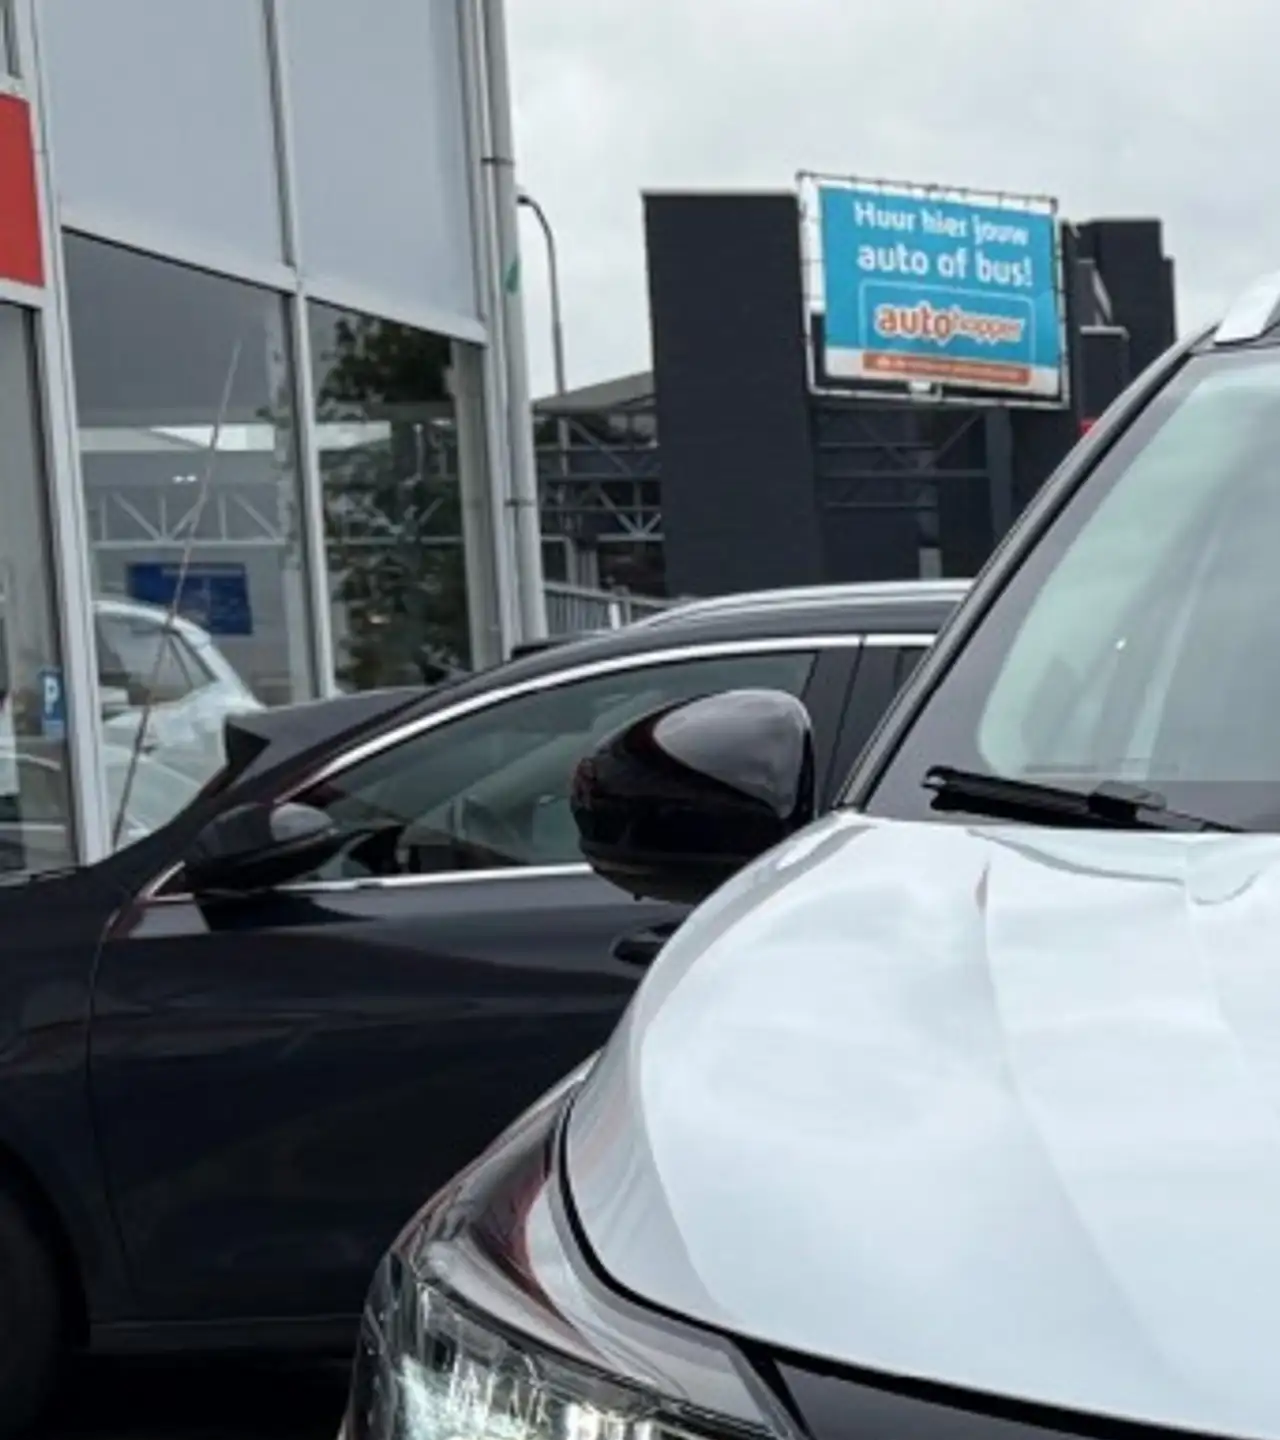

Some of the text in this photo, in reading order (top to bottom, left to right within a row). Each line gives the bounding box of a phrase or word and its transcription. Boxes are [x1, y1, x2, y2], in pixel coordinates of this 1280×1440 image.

[854, 201, 1029, 247] Huur hier jouw
[857, 243, 1033, 288] auto of bus!
